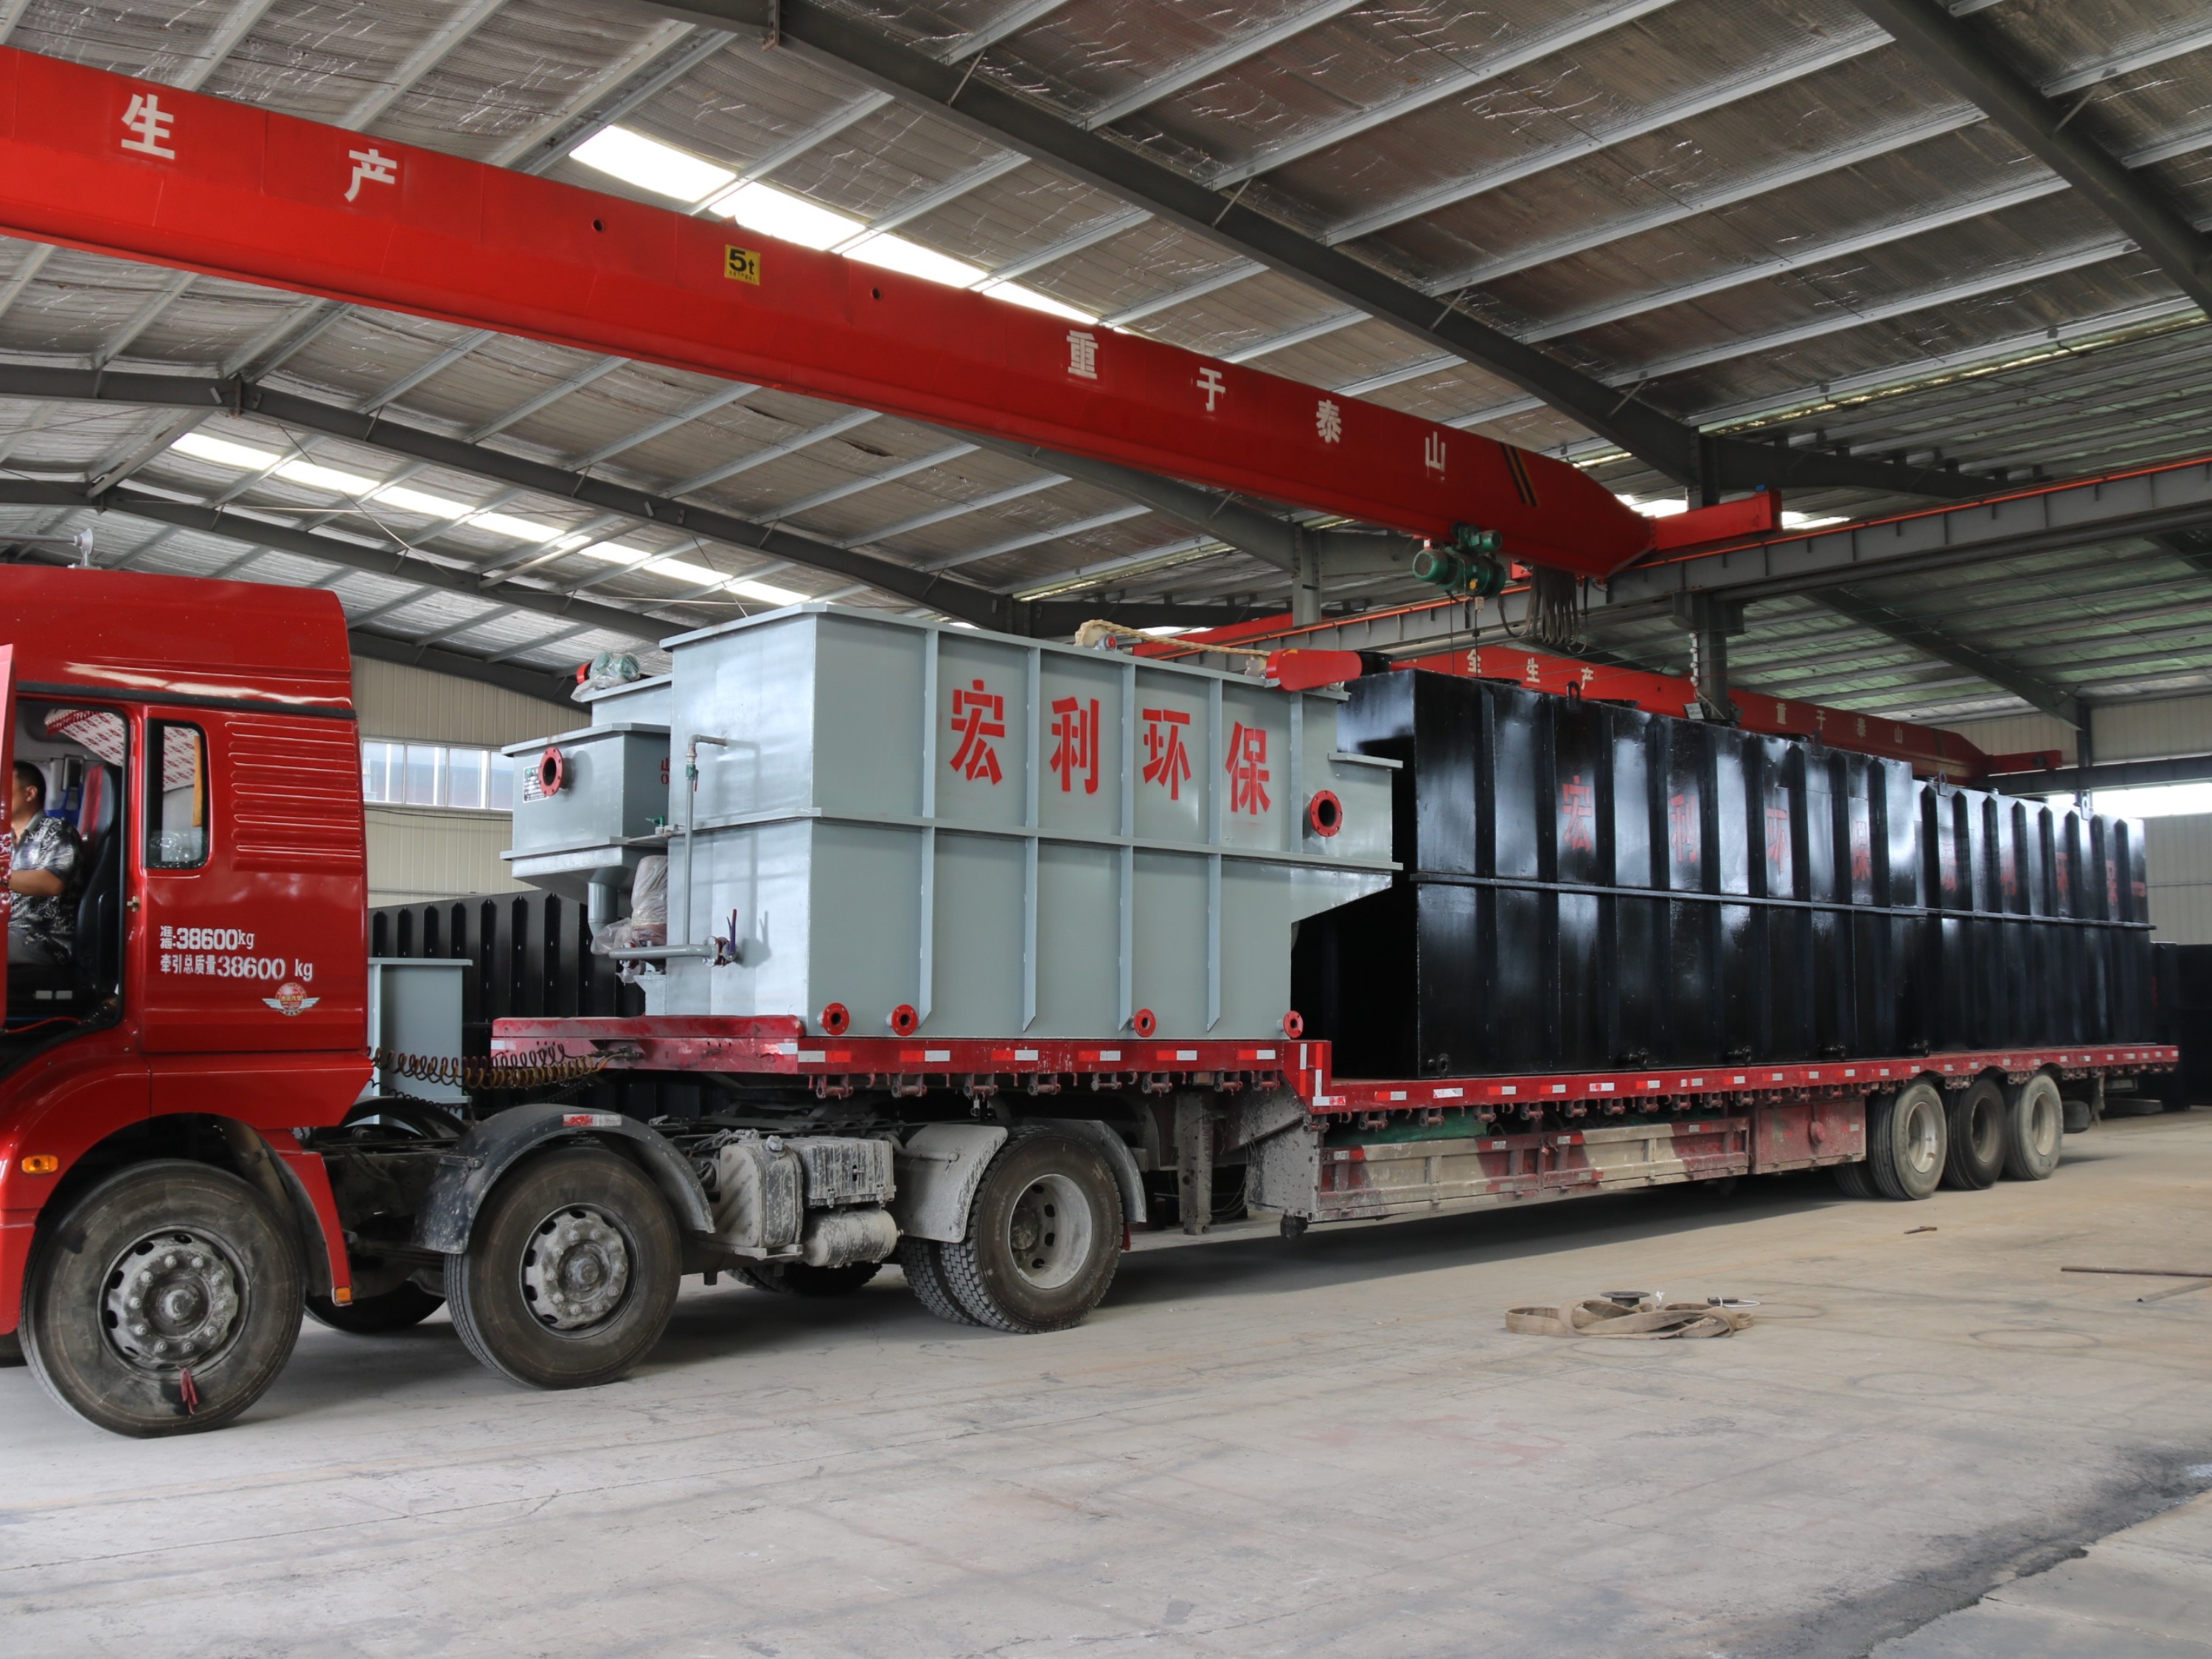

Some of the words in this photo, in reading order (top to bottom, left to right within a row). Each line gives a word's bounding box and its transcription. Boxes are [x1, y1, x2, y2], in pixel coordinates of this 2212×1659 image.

[121, 94, 397, 202] 生产
[728, 248, 754, 275] 5t
[1066, 330, 1446, 474] 重于泰山
[950, 679, 1270, 815] 宏利环保
[294, 959, 313, 981] kg
